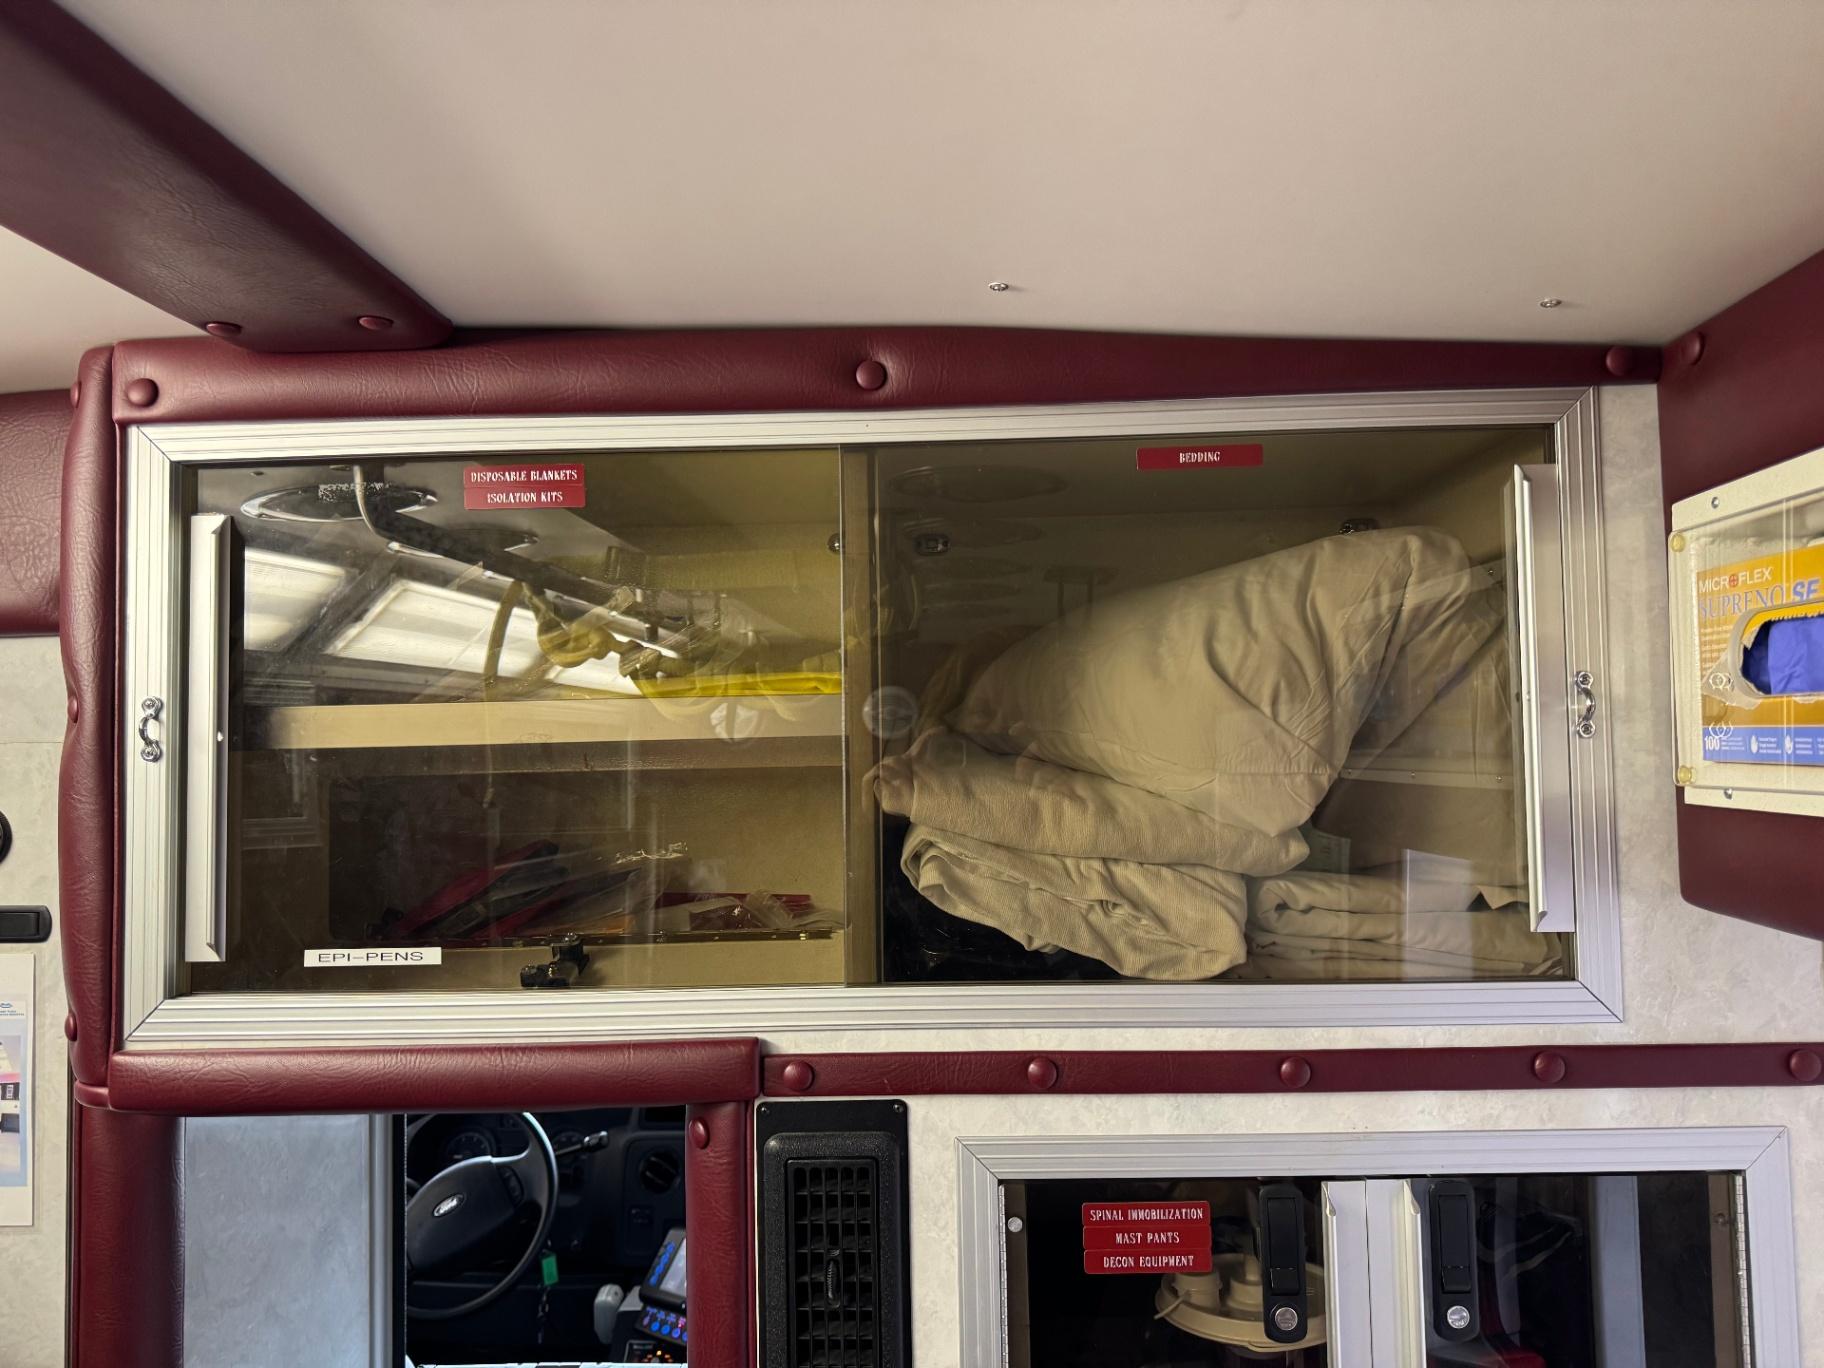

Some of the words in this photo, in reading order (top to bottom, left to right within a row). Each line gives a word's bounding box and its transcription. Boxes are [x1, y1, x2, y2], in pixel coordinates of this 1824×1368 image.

[1179, 451, 1221, 464] BEDDING
[470, 471, 527, 483] DISPOSABLE
[530, 469, 578, 481] BLANKETS
[487, 492, 537, 504] ISOLATION
[540, 491, 563, 502] KITS
[1699, 567, 1773, 593] MICROFLEX
[1704, 735, 1720, 750] 100
[318, 951, 424, 963] EPI-PENS
[1090, 1210, 1124, 1221] SPINAL
[1128, 1208, 1203, 1221] IMMOBILIZATION
[1115, 1232, 1142, 1245] MAST
[1147, 1231, 1180, 1244] PANTS
[1103, 1256, 1134, 1268] DECON
[1139, 1255, 1194, 1267] EQUIPMENT
